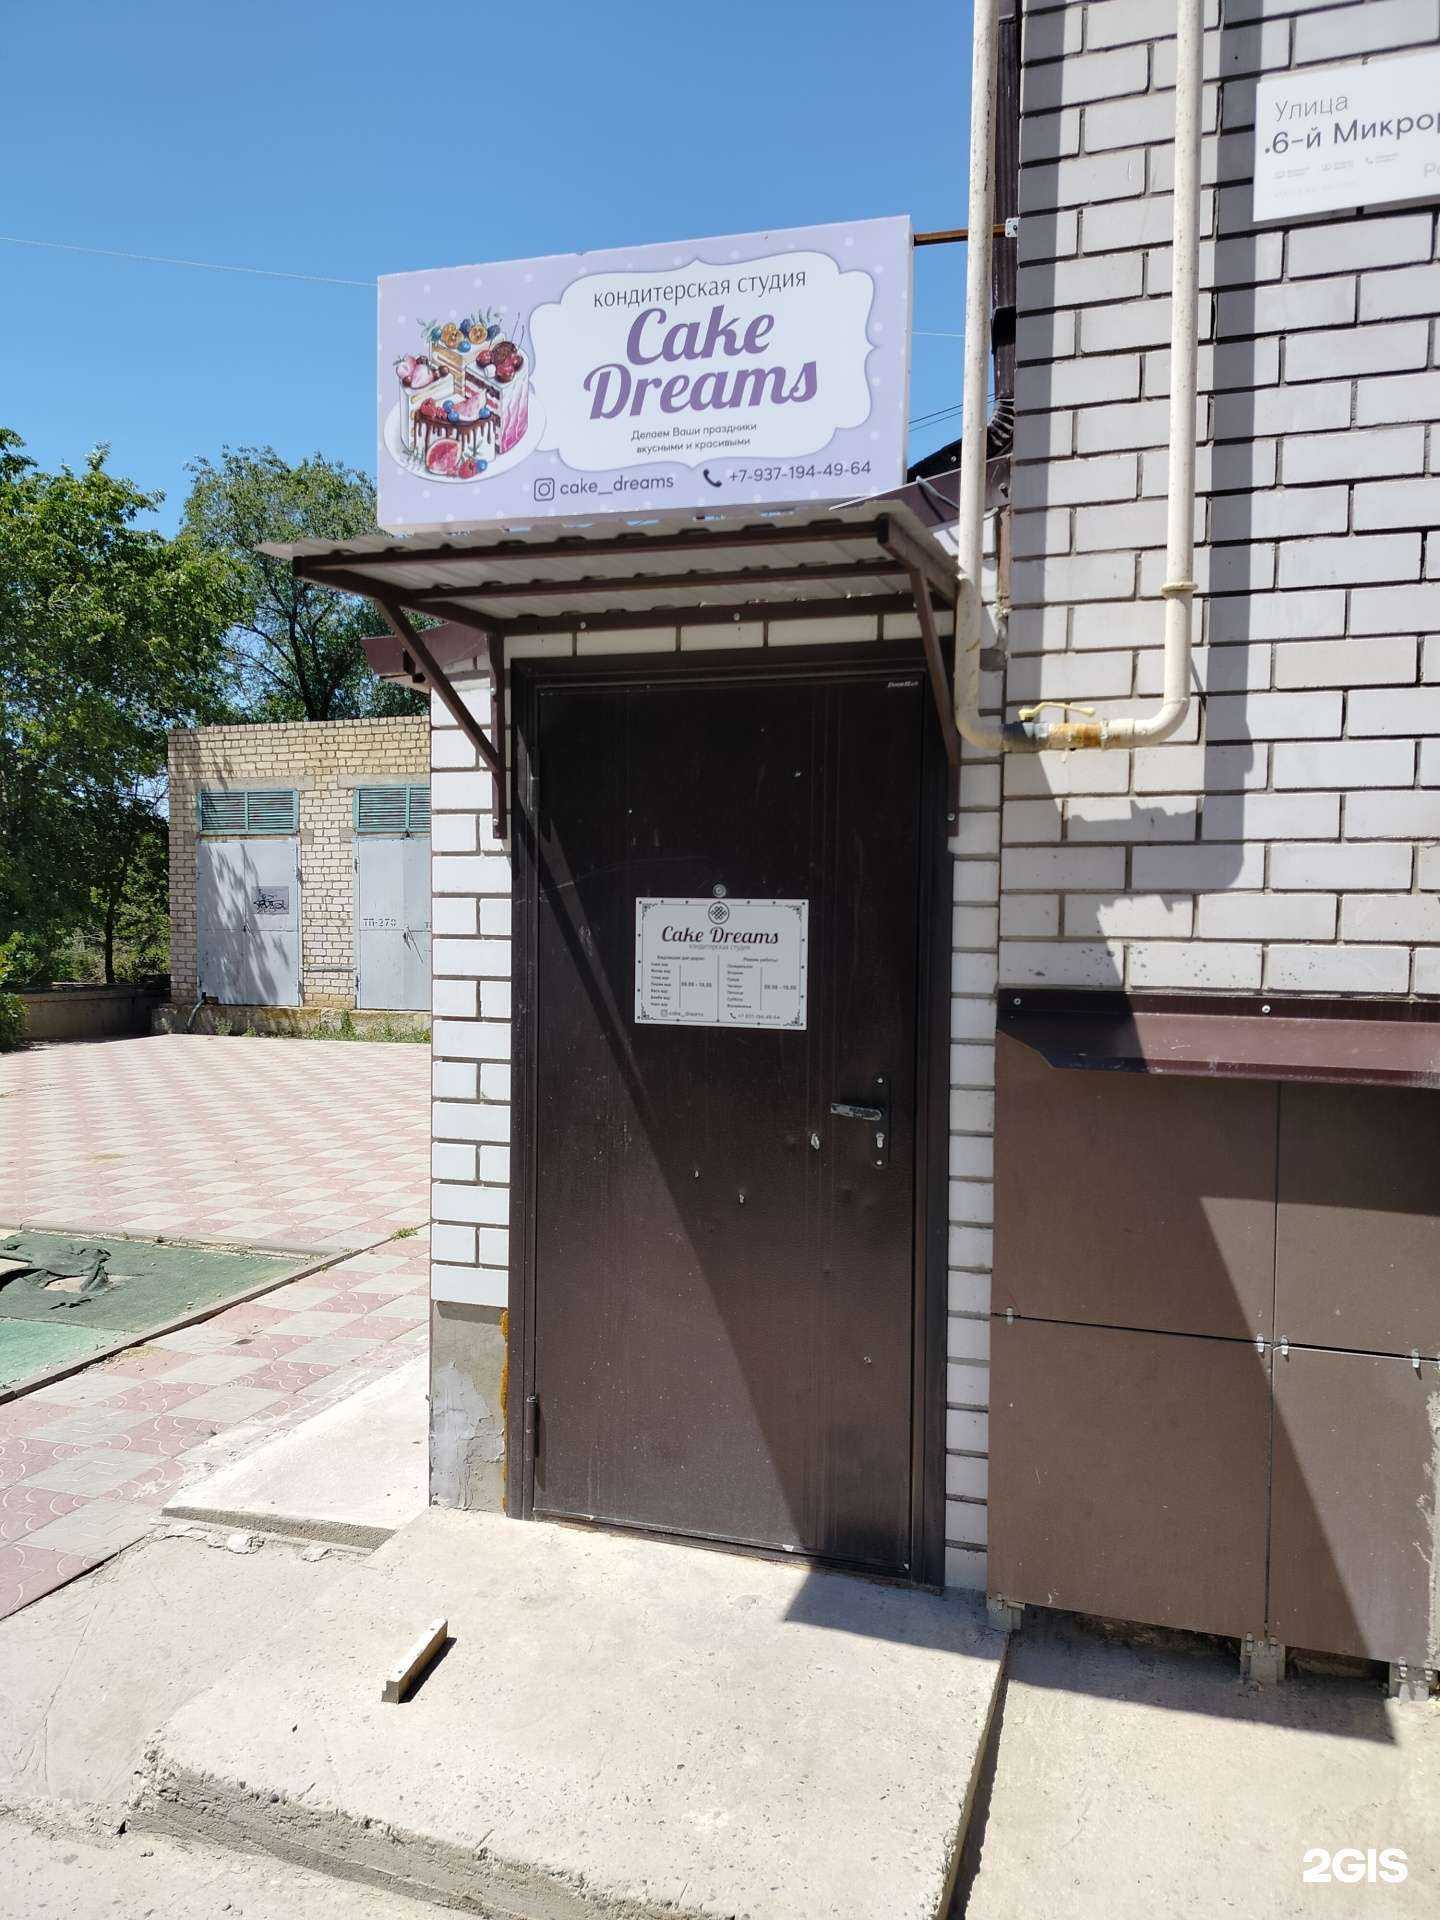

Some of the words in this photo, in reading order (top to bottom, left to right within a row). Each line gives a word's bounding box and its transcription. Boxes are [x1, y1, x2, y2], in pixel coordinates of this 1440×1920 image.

[1275, 96, 1348, 122] Улица
[594, 279, 730, 308] кондитерская
[737, 271, 806, 298] студия
[626, 304, 775, 366] Cake
[583, 360, 818, 420] Dreams
[631, 430, 670, 442] Делаем
[672, 427, 701, 437] Ваши
[703, 423, 757, 436] праздники
[636, 443, 683, 455] вкусными
[685, 442, 692, 450] и
[695, 438, 750, 452] красивыми
[729, 461, 871, 484] +7-937-194-49-64
[661, 925, 704, 942] Cake
[710, 926, 779, 944] Dreams
